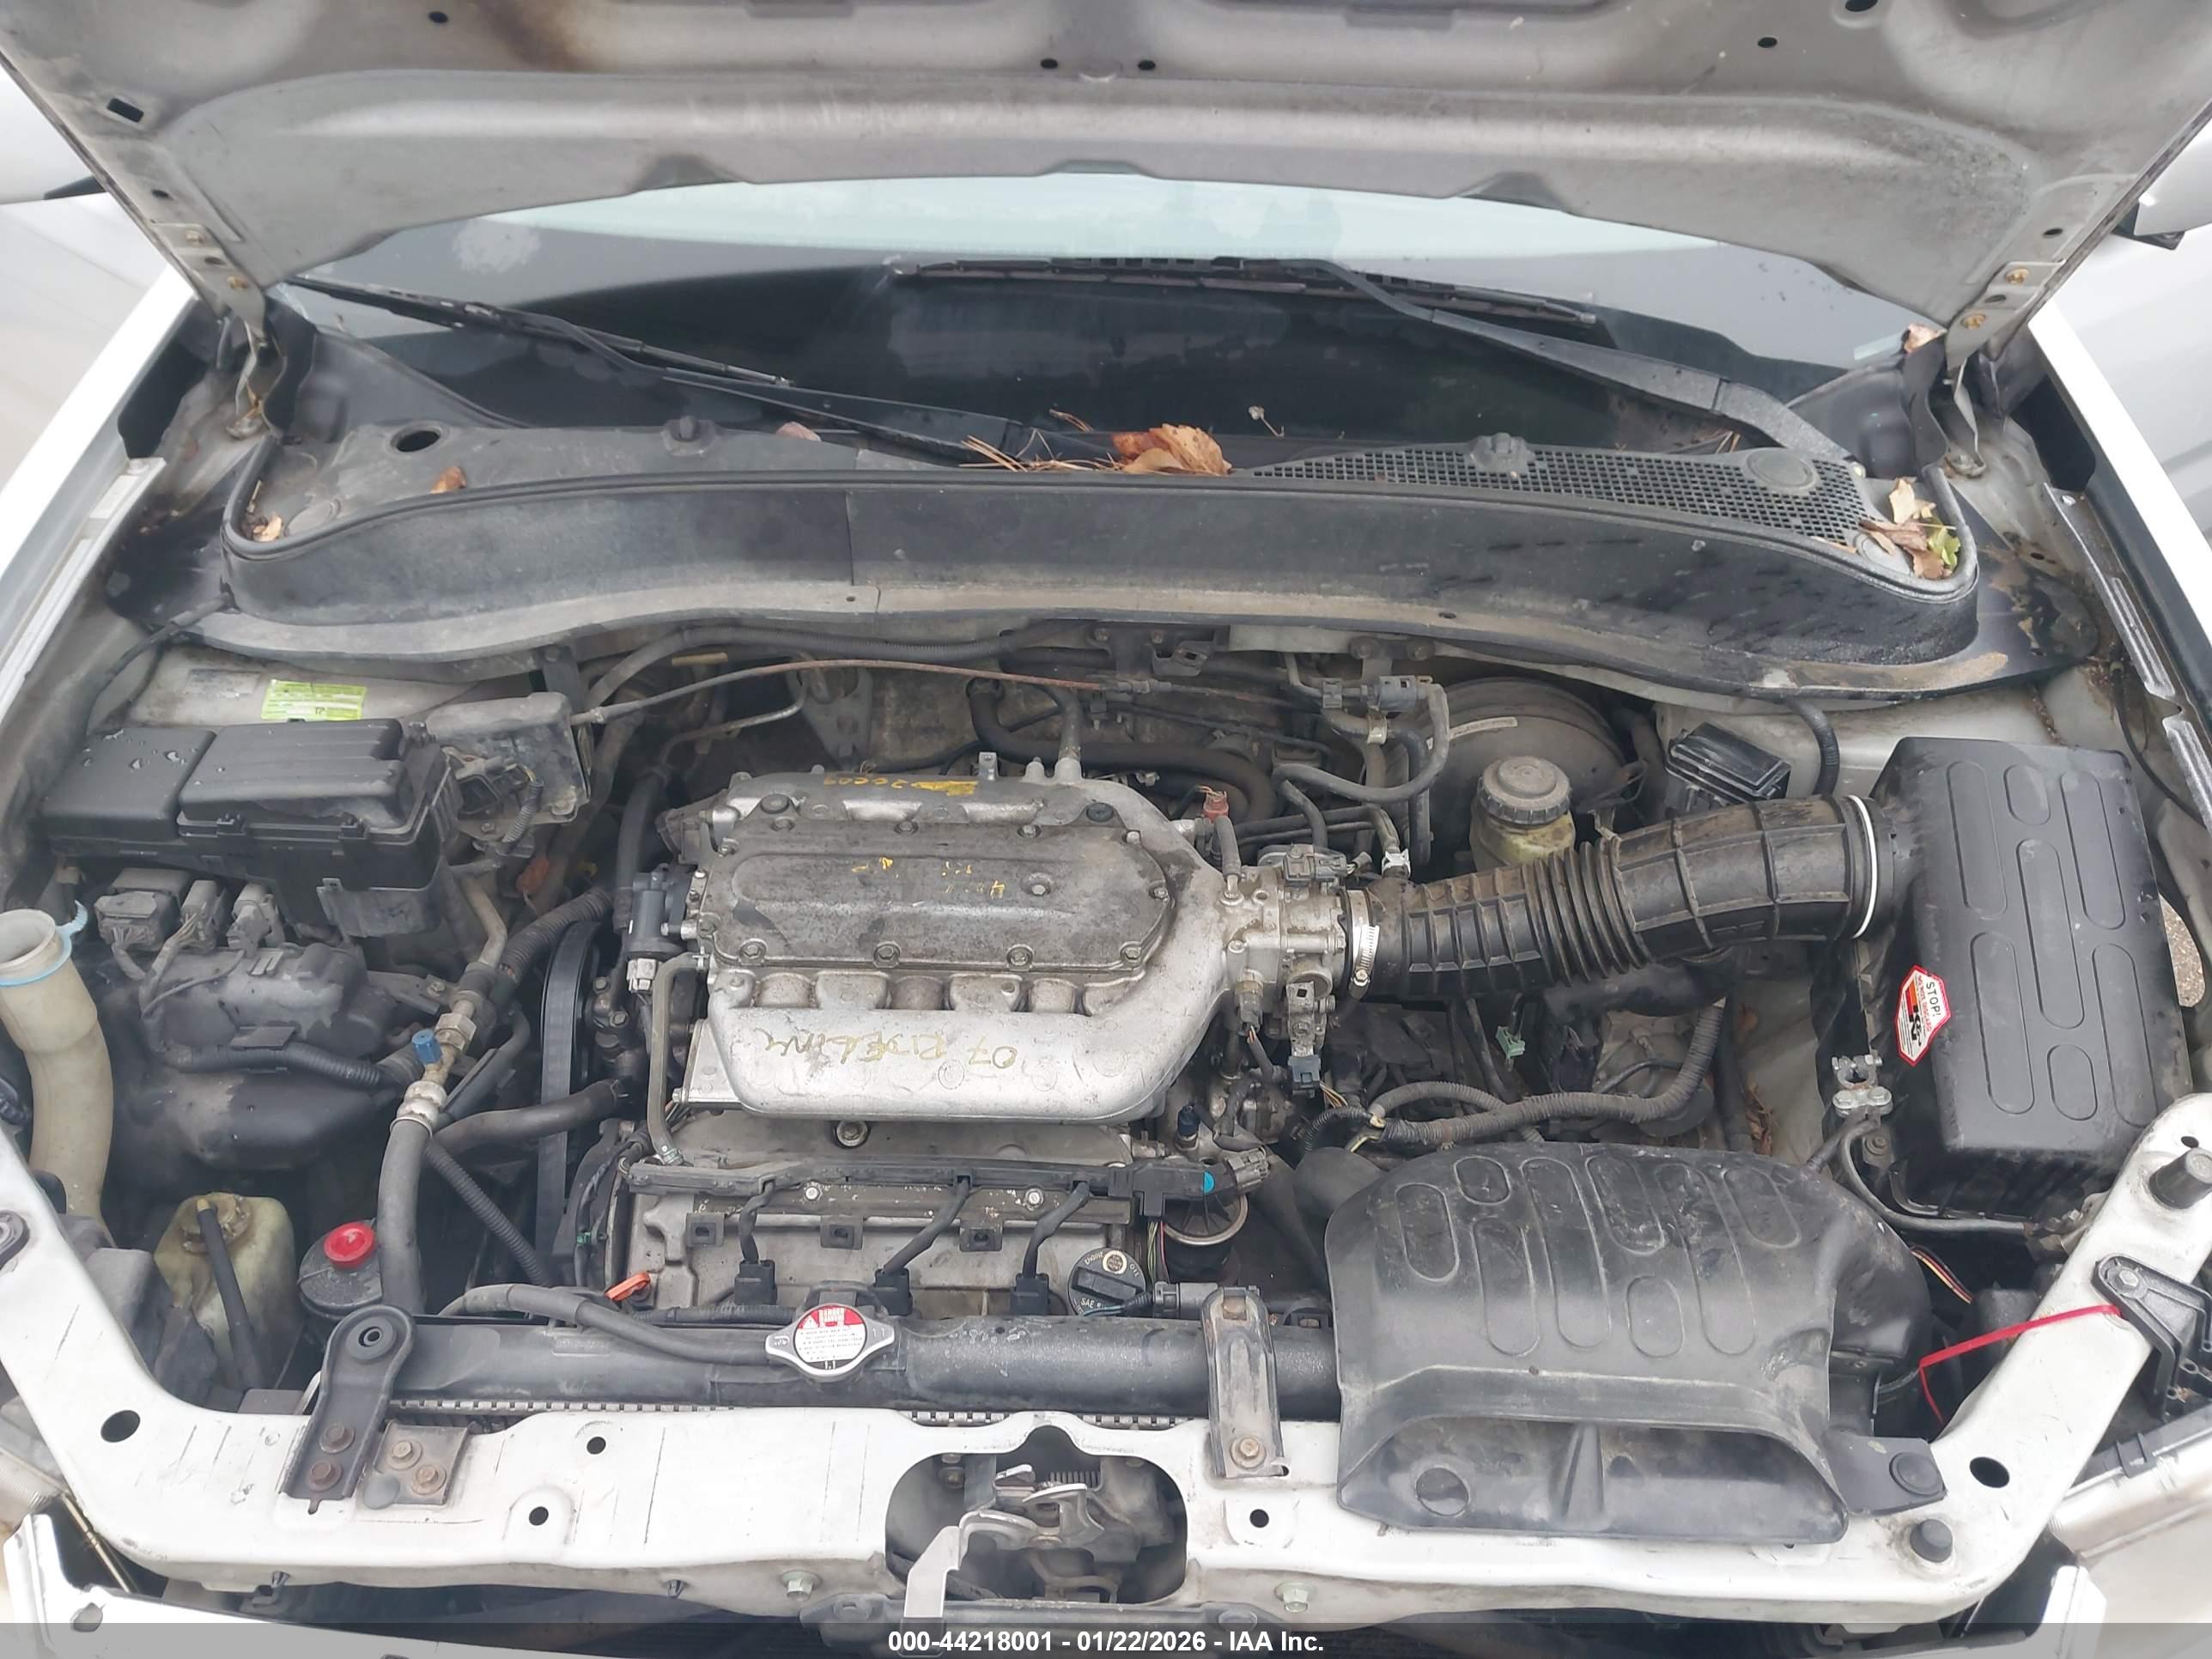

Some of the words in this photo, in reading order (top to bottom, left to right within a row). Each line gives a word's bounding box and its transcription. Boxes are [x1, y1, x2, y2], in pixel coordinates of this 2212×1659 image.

[1926, 981, 1942, 1017] STOP!
[1129, 1263, 1140, 1278] OIL
[1080, 1297, 1095, 1309] SAE
